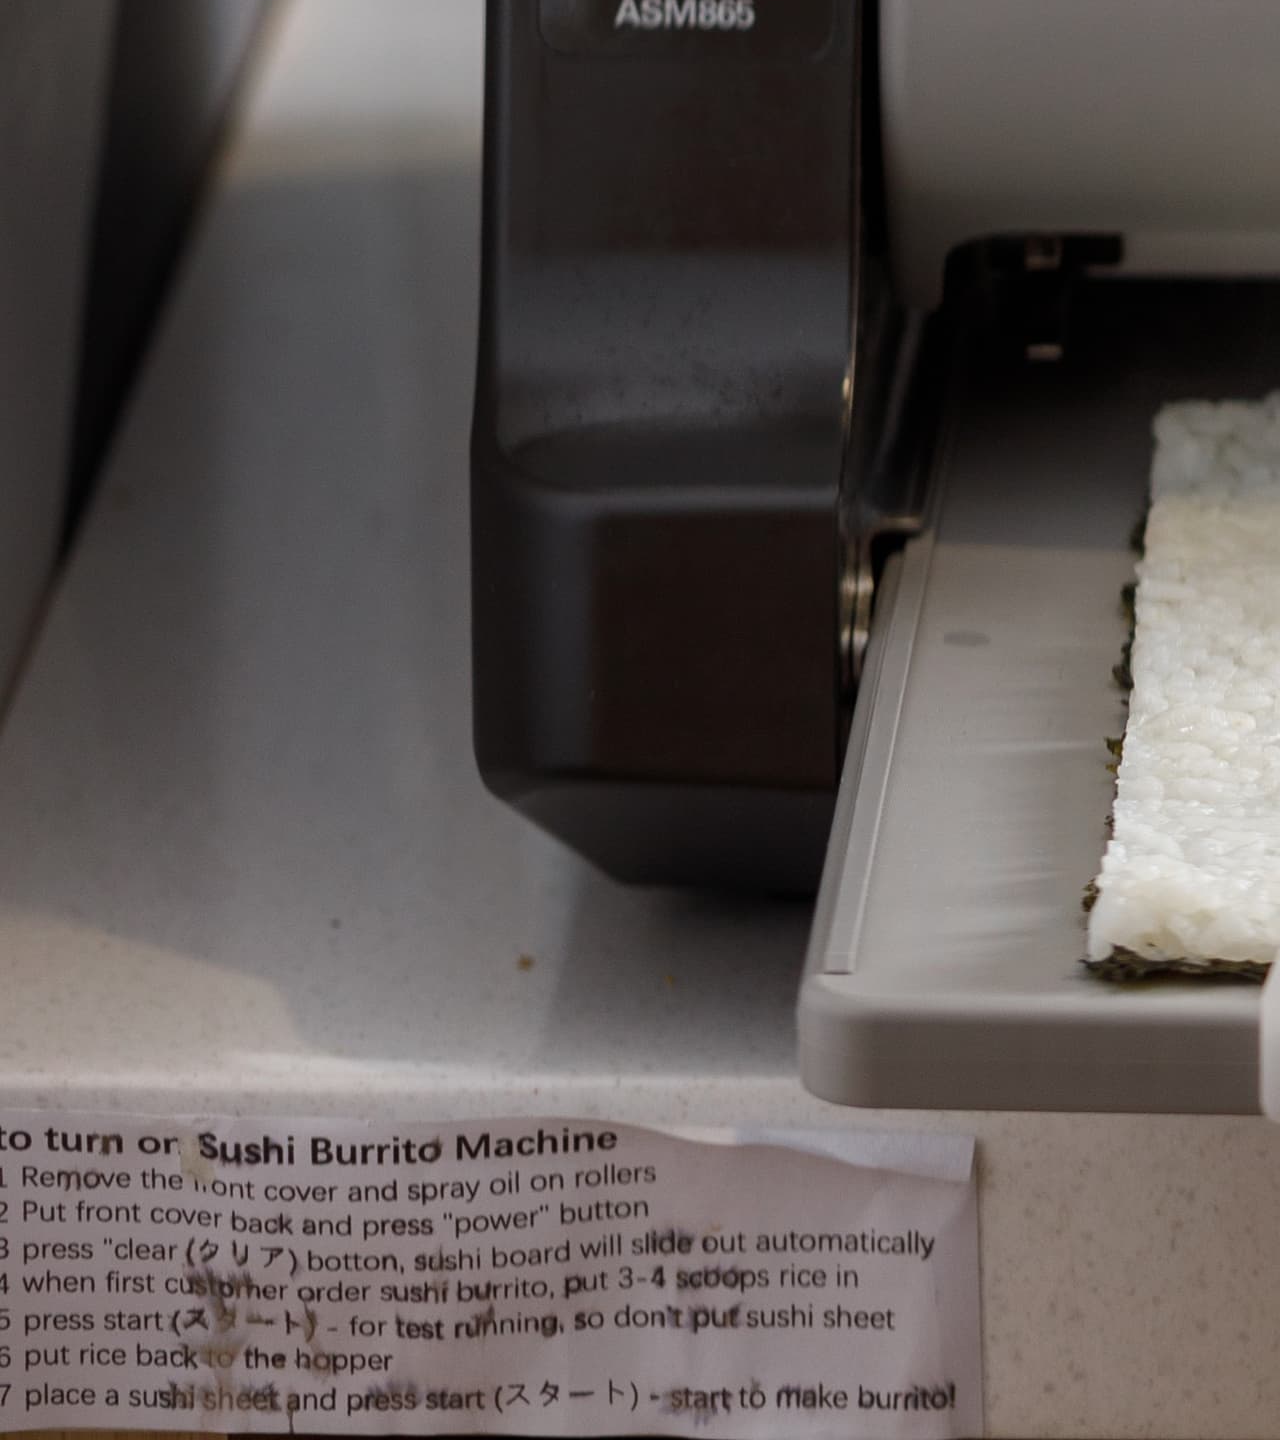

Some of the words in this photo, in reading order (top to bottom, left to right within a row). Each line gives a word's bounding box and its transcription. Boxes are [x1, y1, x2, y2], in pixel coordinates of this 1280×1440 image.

[45, 1127, 124, 1155] turn
[199, 1131, 295, 1167] Sushi
[311, 1136, 443, 1166] Burrito
[456, 1128, 618, 1160] Machine
[22, 1166, 131, 1190] Remove
[141, 1167, 183, 1191] the
[264, 1183, 338, 1203] cover
[348, 1179, 398, 1203] and
[408, 1179, 481, 1205] spray
[489, 1170, 520, 1196] oil
[530, 1172, 564, 1192] on
[575, 1163, 657, 1188] rollers
[23, 1201, 67, 1223] Put
[75, 1200, 141, 1224] front
[150, 1207, 222, 1229] cover
[231, 1210, 294, 1236] back
[302, 1215, 352, 1237] and
[363, 1216, 434, 1241] press
[443, 1205, 549, 1239] "power"
[560, 1199, 649, 1225] button
[23, 1240, 94, 1265] press
[103, 1237, 178, 1261] "clear
[308, 1249, 405, 1274] botton,
[414, 1247, 482, 1272] sushi
[492, 1240, 570, 1269] board
[580, 1234, 622, 1259] will
[631, 1229, 694, 1256] slide
[702, 1231, 746, 1255] out
[756, 1229, 936, 1261] automatically
[22, 1269, 96, 1293] when
[106, 1270, 155, 1293] first
[164, 1274, 289, 1301] customer
[298, 1281, 371, 1303] order
[380, 1281, 448, 1304] sushi
[457, 1277, 554, 1302] burrito,
[564, 1271, 608, 1300] put
[618, 1266, 667, 1289] 3-4
[676, 1266, 770, 1293] scoops
[779, 1263, 827, 1288] rice
[836, 1263, 859, 1288] in
[24, 1312, 95, 1336] press
[104, 1311, 164, 1332] start
[350, 1315, 387, 1337] for
[395, 1314, 445, 1340] test
[454, 1310, 564, 1339] running,
[574, 1310, 604, 1330] so
[614, 1304, 682, 1329] don't
[694, 1305, 740, 1334] put
[747, 1303, 814, 1329] sushi
[823, 1304, 896, 1330] sheet
[24, 1344, 70, 1371] put
[79, 1342, 127, 1366] rice
[136, 1342, 198, 1370] back
[206, 1347, 235, 1367] to
[244, 1347, 287, 1370] the
[296, 1347, 394, 1374] hopper
[25, 1382, 96, 1411] place
[105, 1388, 119, 1407] a
[129, 1383, 195, 1410] sushi
[203, 1386, 281, 1411] sheet
[287, 1387, 337, 1412] and
[347, 1390, 419, 1416] press
[425, 1388, 486, 1411] start
[671, 1386, 731, 1411] start
[739, 1385, 766, 1410] to
[776, 1382, 849, 1410] make
[858, 1382, 957, 1412] burrito!
